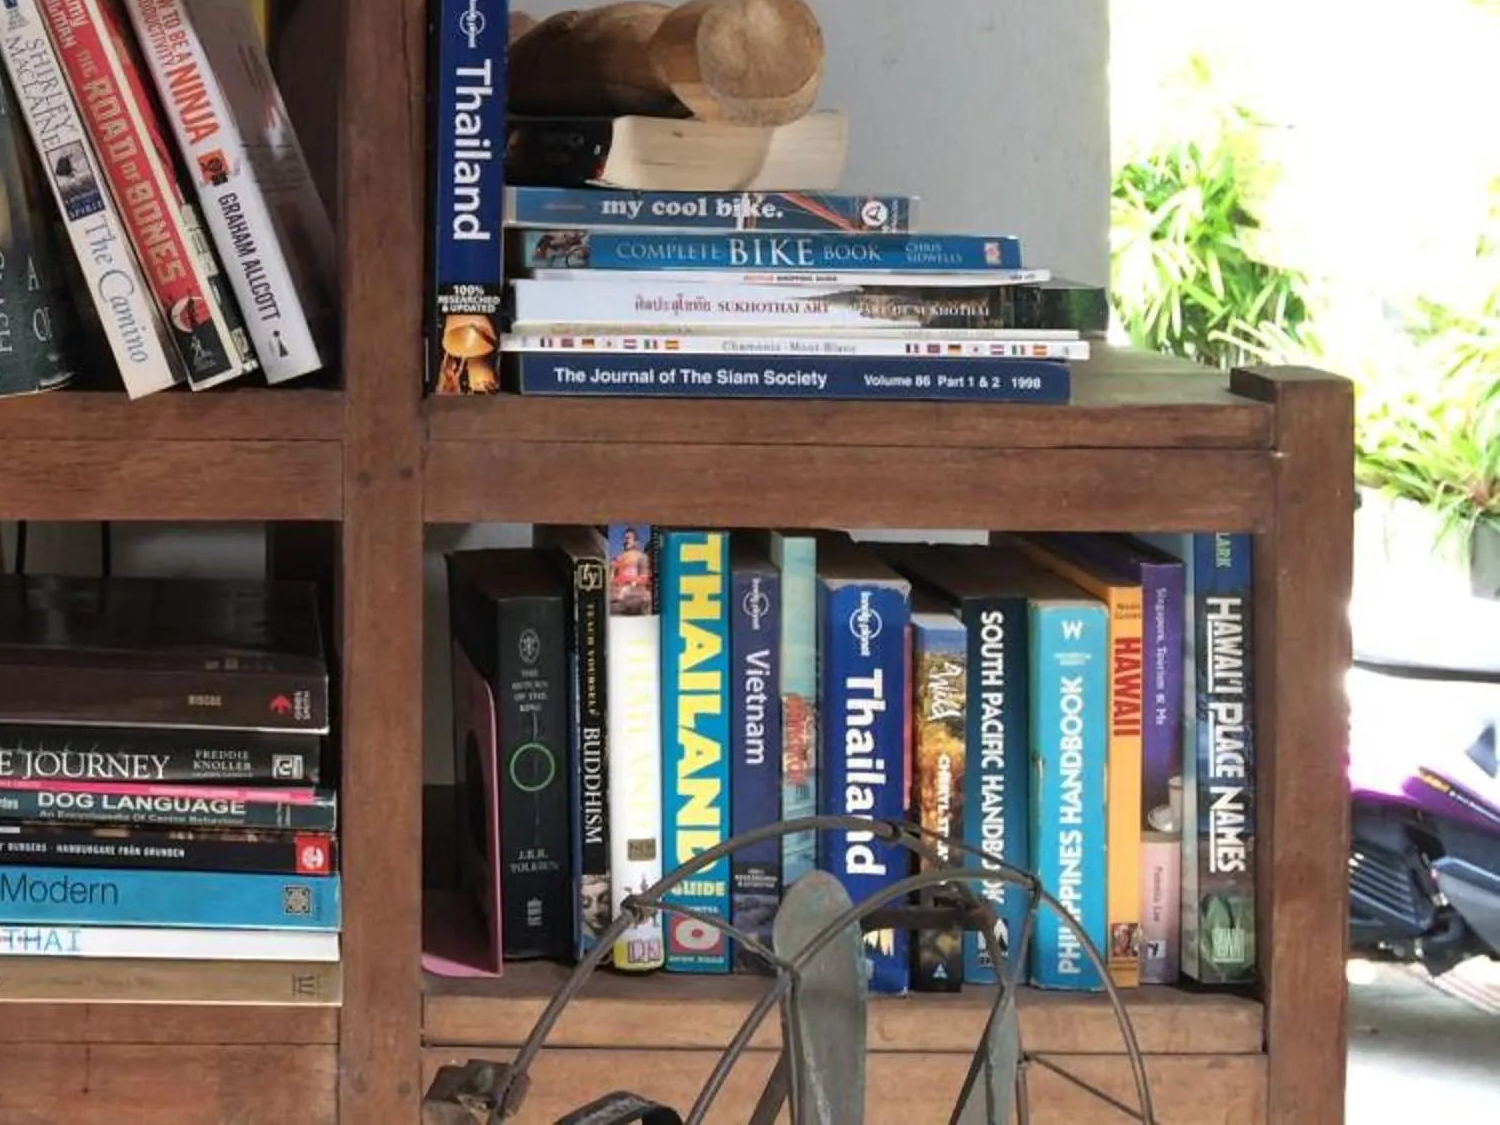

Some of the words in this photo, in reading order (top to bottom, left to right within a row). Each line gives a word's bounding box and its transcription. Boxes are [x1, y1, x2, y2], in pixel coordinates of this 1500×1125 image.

[162, 10, 181, 30] TO
[169, 31, 192, 55] BE
[25, 37, 76, 133] SHIRLEY
[164, 61, 220, 146] NINJA
[82, 75, 138, 162] ROAD
[124, 180, 188, 286] BONES
[452, 58, 494, 241] Thailand
[83, 213, 117, 266] The
[601, 197, 644, 218] my
[651, 197, 707, 217] cool
[217, 191, 258, 258] GRAHAM
[241, 259, 281, 322] ALLCOTT
[616, 241, 722, 261] COMPLETE
[728, 237, 816, 267] BIKE
[823, 244, 882, 262] BOOK
[98, 268, 149, 364] Camino
[553, 367, 586, 383] The
[590, 367, 654, 383] Journal
[659, 367, 676, 383] of
[680, 368, 712, 384] The
[717, 369, 759, 385] Siam
[763, 369, 828, 390] Society
[864, 374, 912, 387] Volume
[937, 375, 965, 388] Part
[979, 376, 990, 388] &
[981, 611, 1005, 686] SOUTH
[1113, 637, 1141, 737] HAWAII
[676, 533, 722, 874] THAILAND
[745, 649, 770, 765] Vietnam
[981, 692, 1005, 769] PACIFIC
[1208, 702, 1244, 779] PLACE
[20, 749, 171, 780] JOURNEY
[192, 760, 252, 771] KNOLLER
[195, 749, 250, 760] FREDDIE
[583, 727, 603, 844] BUDDHISM
[846, 668, 887, 876] Thailand
[1059, 675, 1084, 825] HANDBOOK
[37, 792, 95, 809] DOG
[101, 793, 247, 815] LANGUAGE
[1209, 786, 1246, 874] NAMES
[1, 872, 118, 906] Modern
